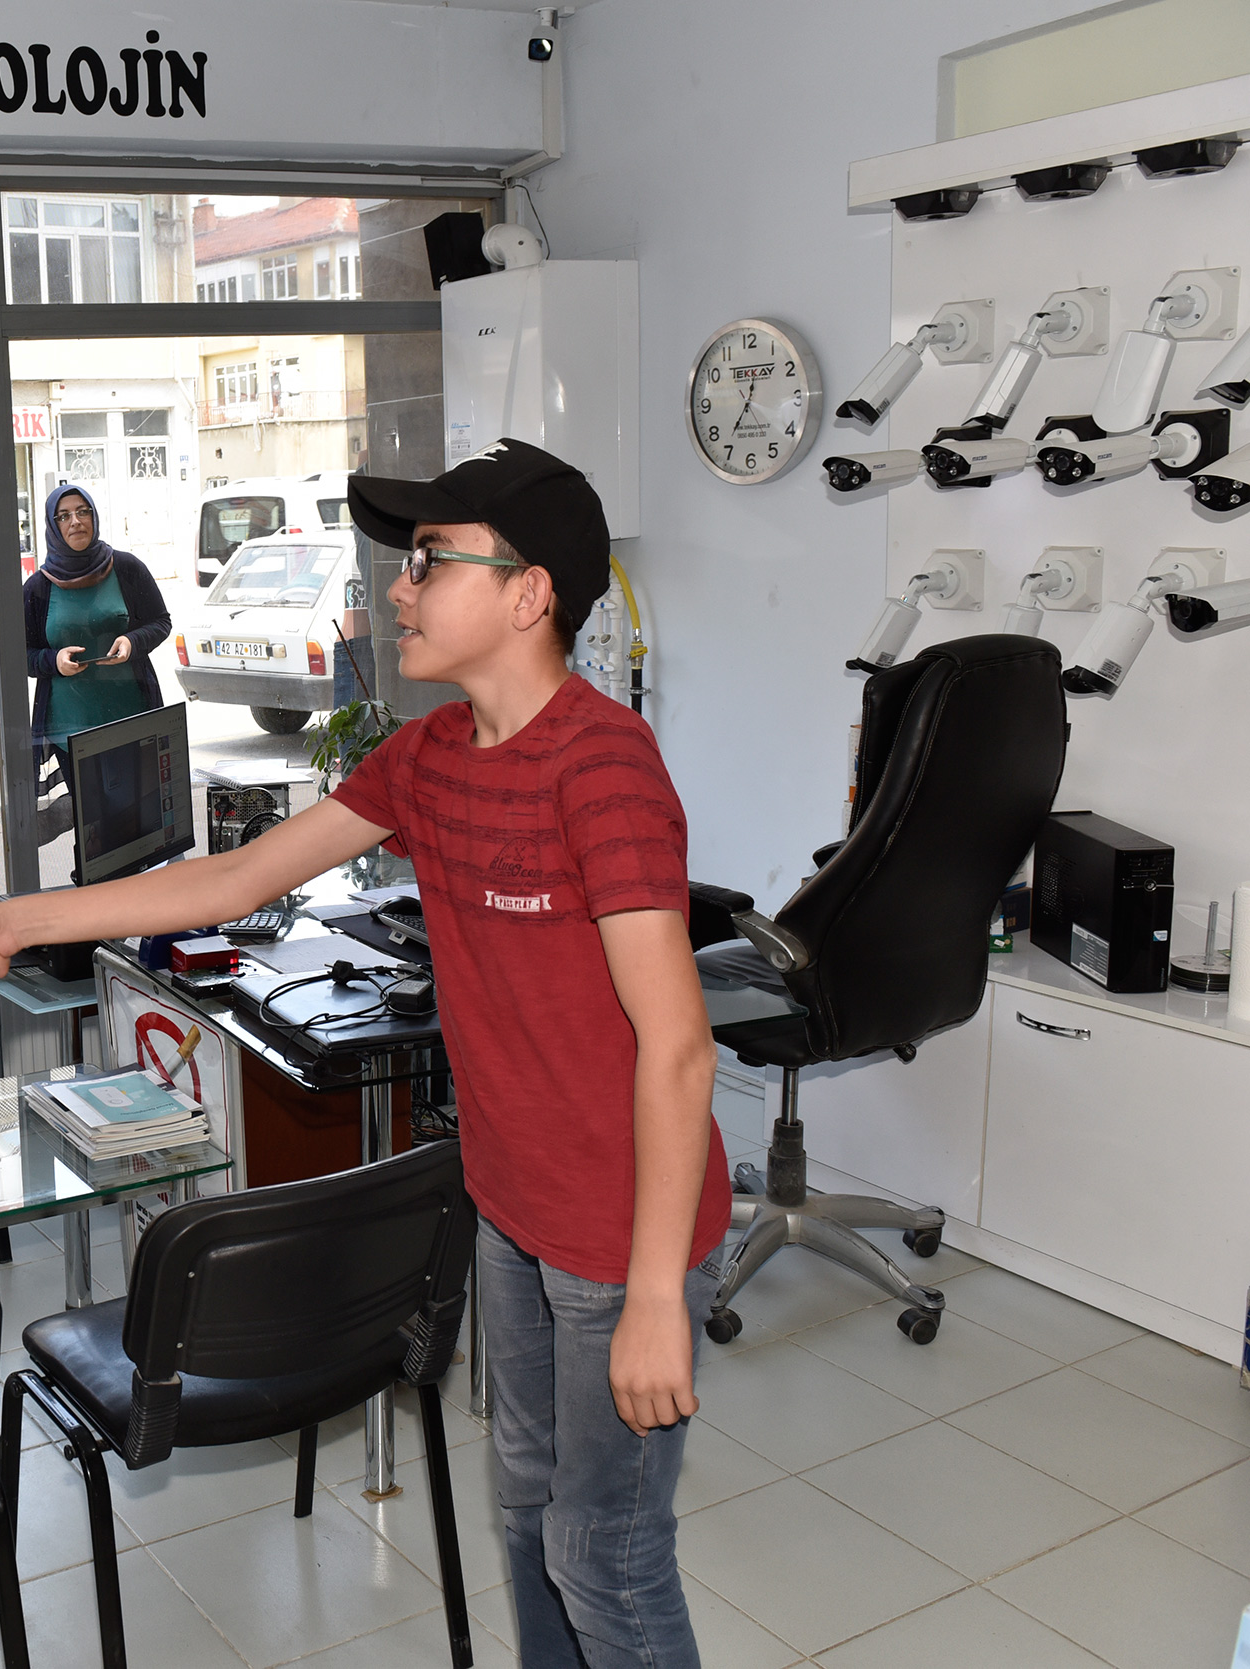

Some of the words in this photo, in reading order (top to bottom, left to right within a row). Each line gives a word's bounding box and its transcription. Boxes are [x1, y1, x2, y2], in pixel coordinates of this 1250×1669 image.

[742, 333, 757, 349] 12
[722, 346, 731, 361] 11
[707, 367, 720, 384] 10
[729, 363, 776, 380] TEKKAY
[784, 361, 796, 377] 2
[701, 398, 712, 414] 9
[793, 389, 802, 407] 3
[708, 425, 719, 441] 8
[784, 420, 796, 437] 4
[724, 445, 734, 460] 7
[768, 442, 778, 458] 5
[745, 453, 756, 469] 6
[221, 643, 230, 655] 42
[234, 643, 244, 656] AZ
[249, 644, 262, 656] 181
[499, 898, 513, 908] PASS
[515, 899, 532, 909] PLAY
